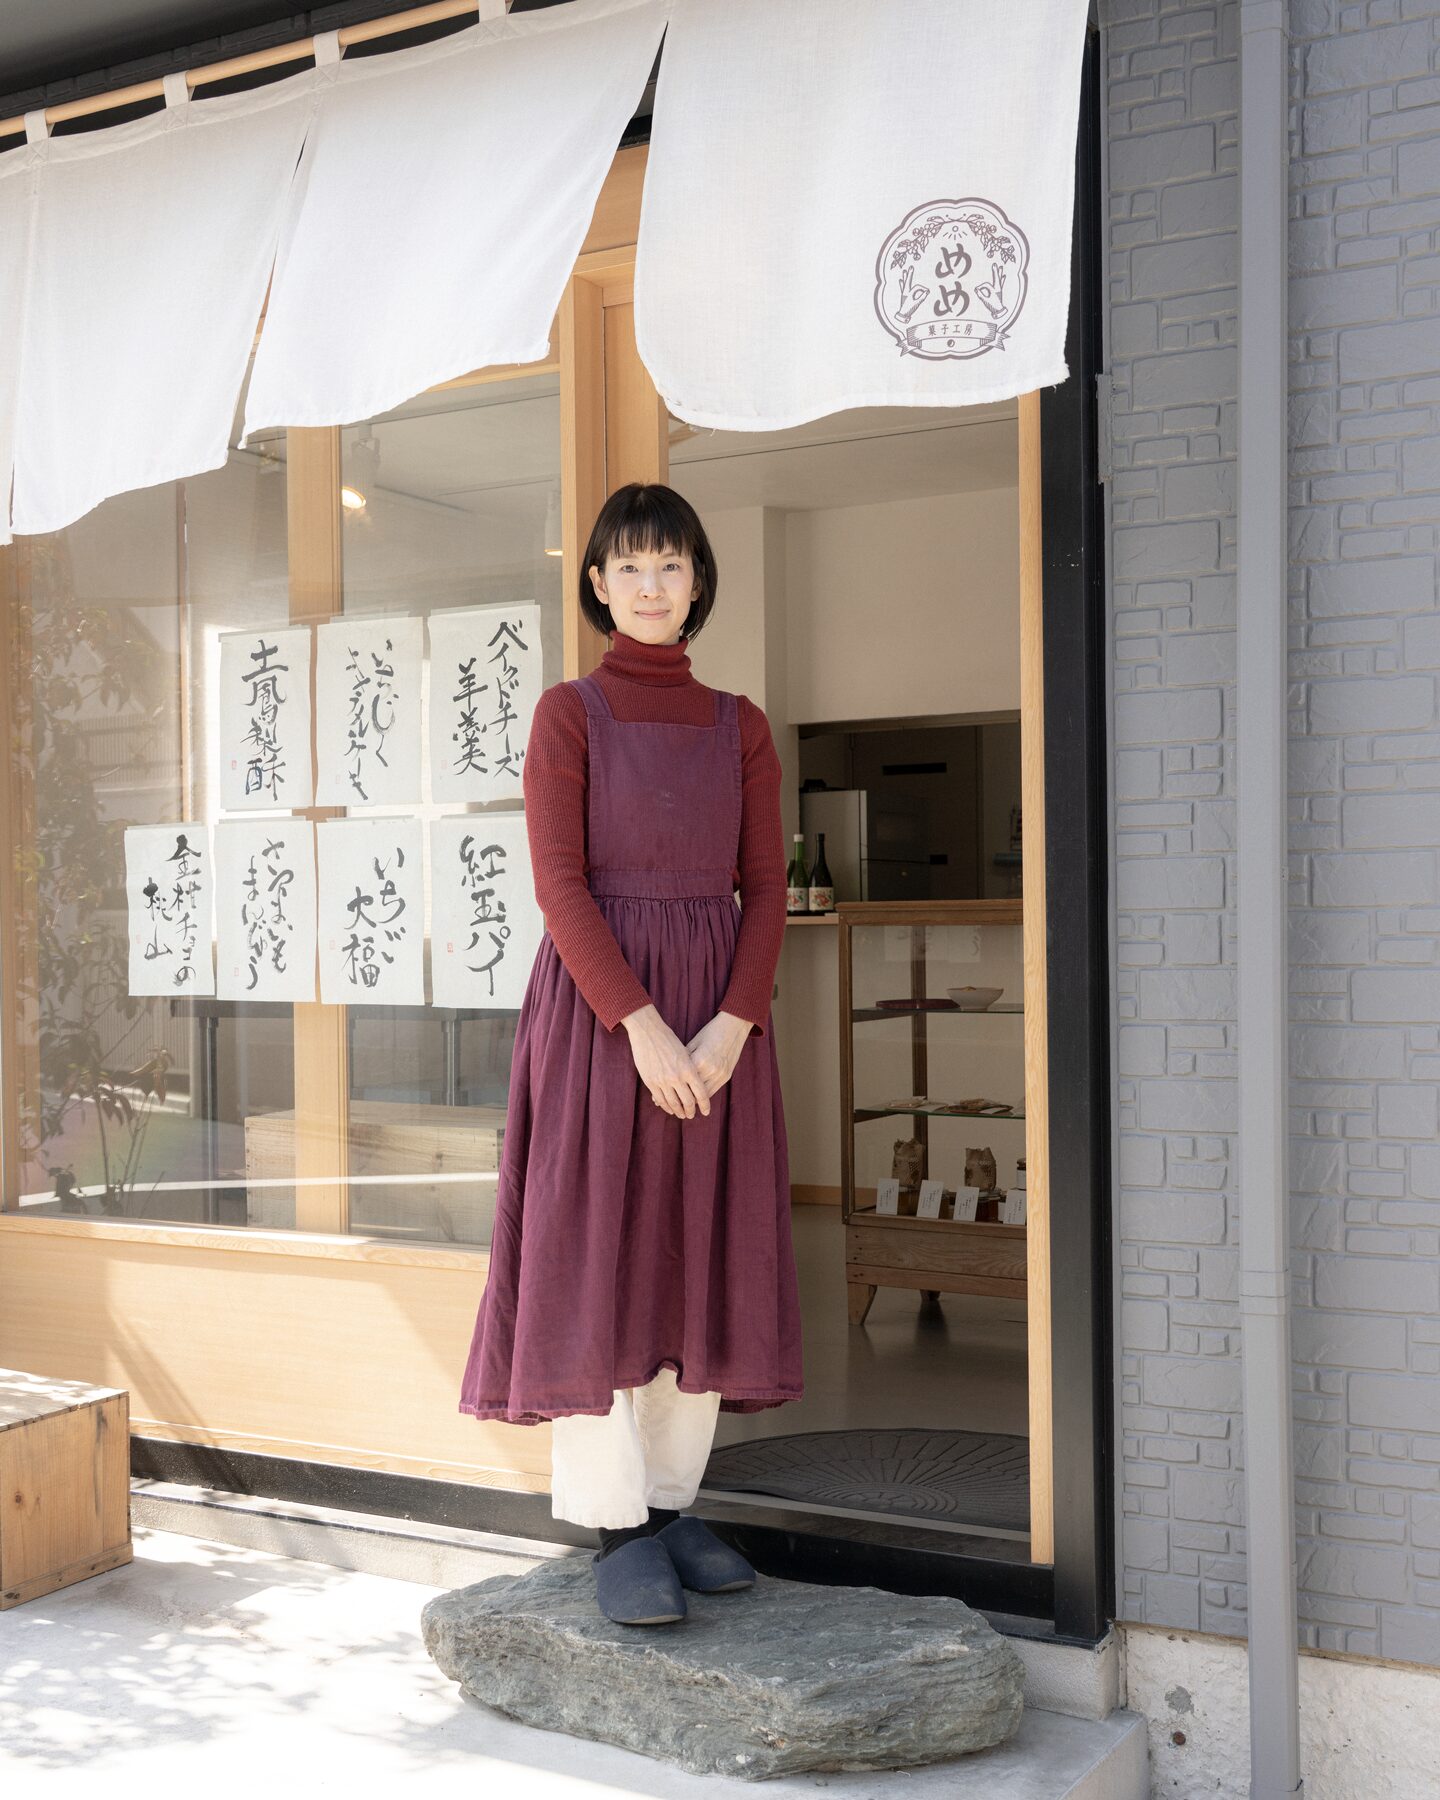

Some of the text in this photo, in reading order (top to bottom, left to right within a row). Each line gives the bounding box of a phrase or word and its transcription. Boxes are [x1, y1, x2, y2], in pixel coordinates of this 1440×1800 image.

[928, 323, 973, 337] 菓子工房
[933, 243, 973, 317] めめ
[240, 639, 289, 802] 土鳳梨酥
[371, 638, 400, 768] いちじく
[453, 657, 489, 775] 羊羹
[487, 620, 529, 778] ベイクドチーズ
[142, 876, 174, 961] 桃山
[241, 855, 269, 991] まんじゅう
[341, 886, 382, 988] 大福
[373, 847, 407, 965] いちご
[459, 835, 512, 997] 紅玉パイ
